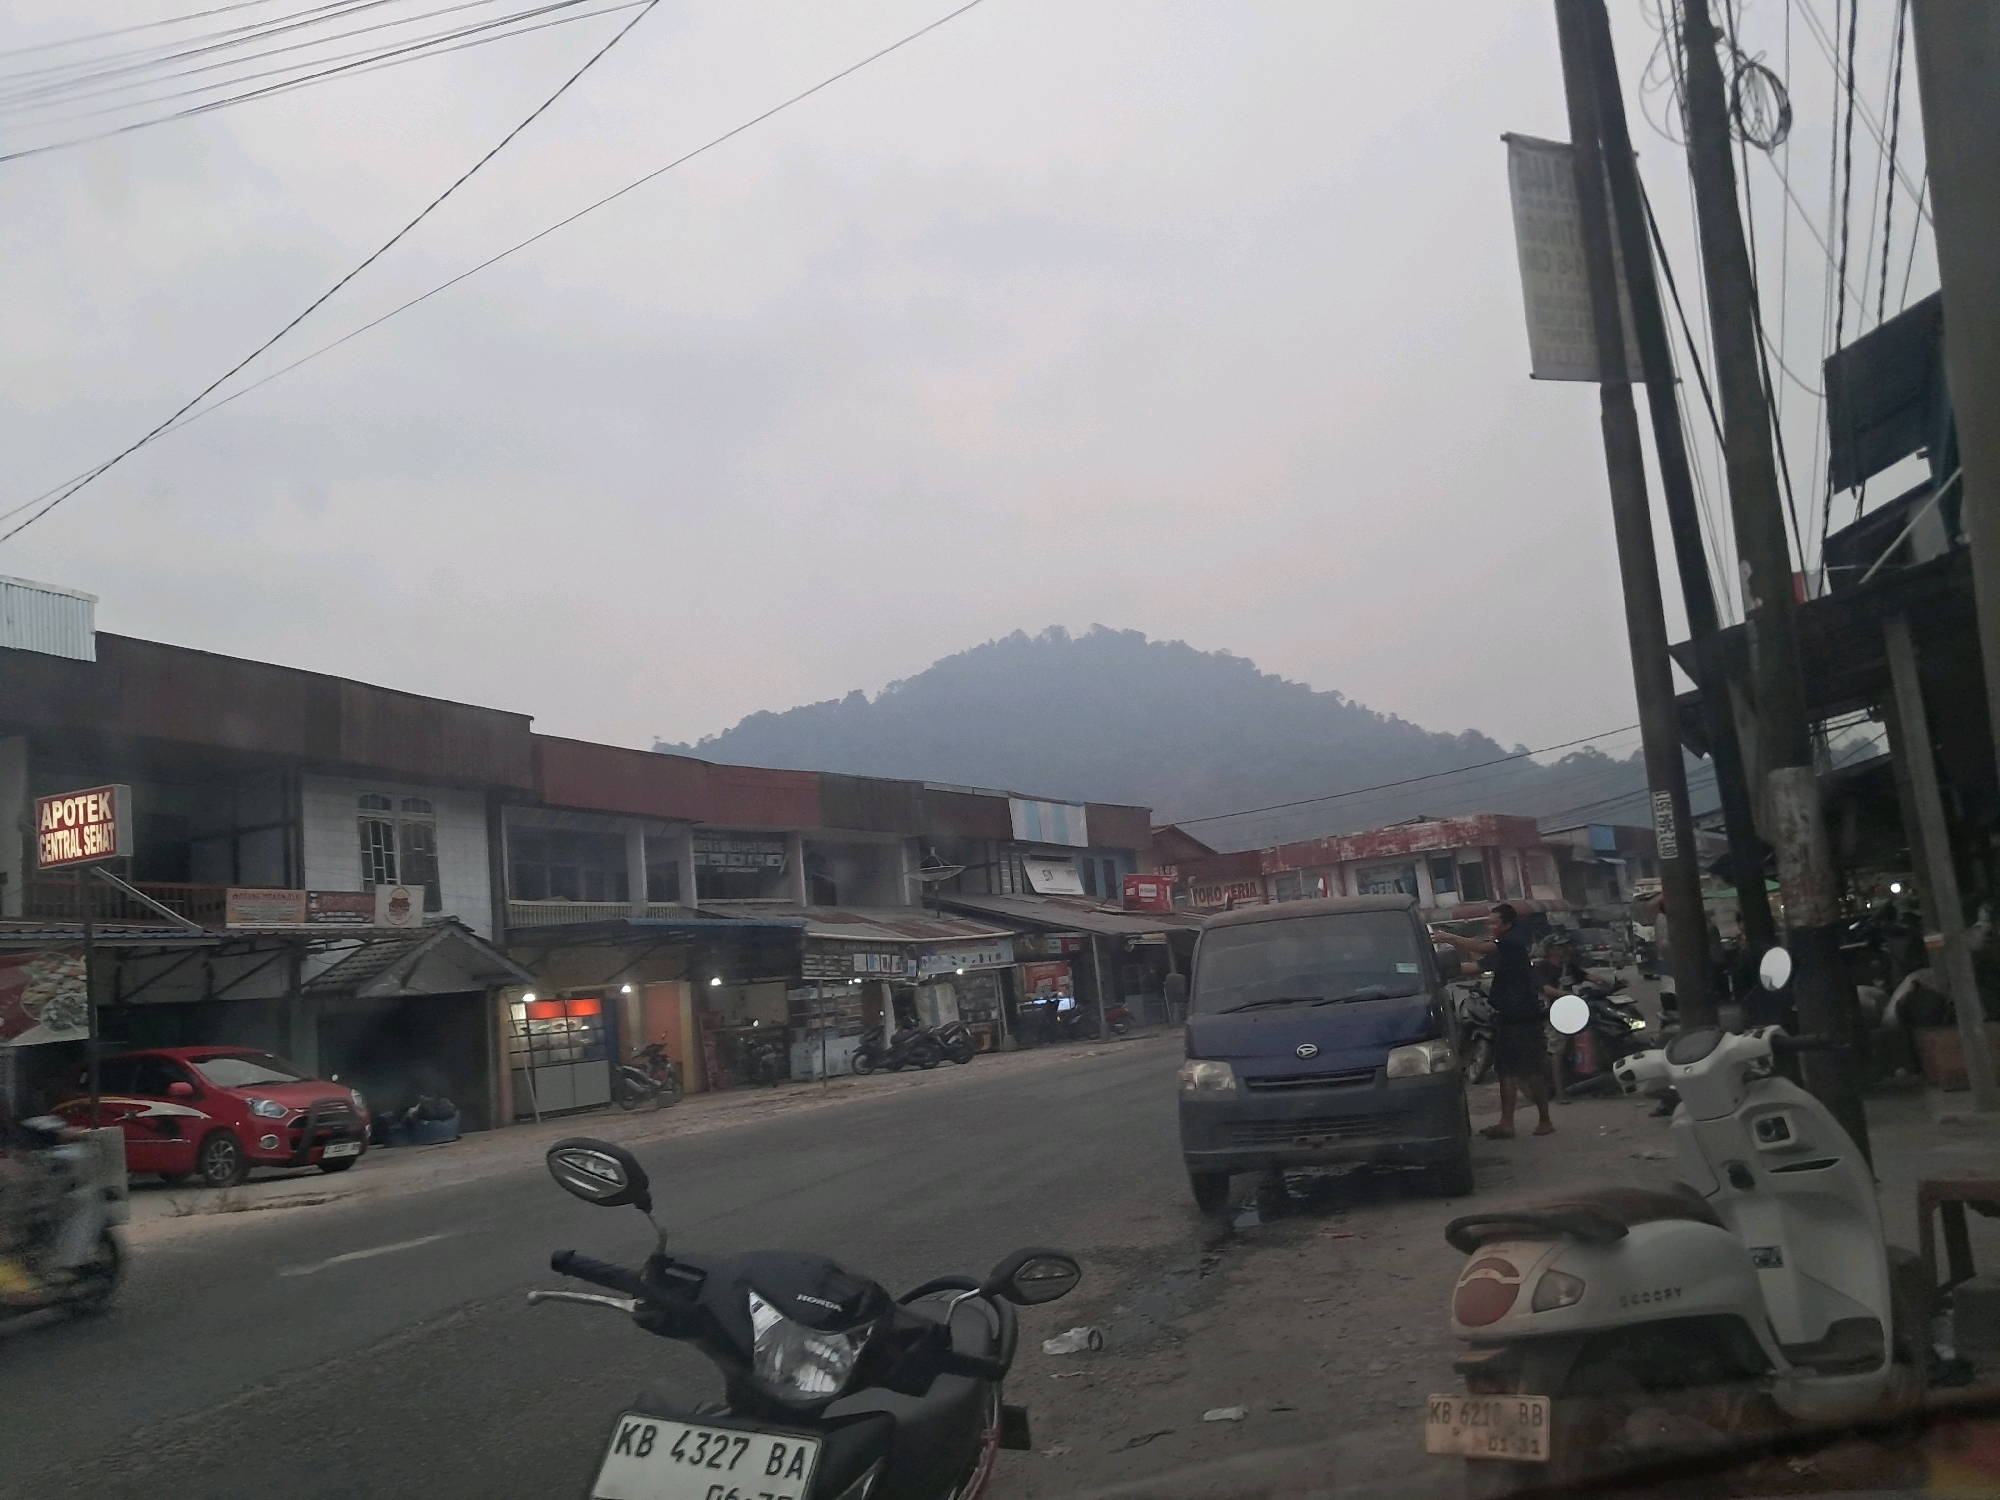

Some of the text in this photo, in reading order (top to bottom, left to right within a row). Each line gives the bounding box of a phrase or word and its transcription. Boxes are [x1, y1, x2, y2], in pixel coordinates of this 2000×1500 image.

[41, 792, 113, 831] APOTEK
[40, 822, 114, 863] CENTRAL SEHAT
[1192, 886, 1222, 904] TOKO
[796, 1293, 843, 1313] HONDA
[1430, 1401, 1451, 1424] KB
[1519, 1402, 1543, 1426] BB
[614, 1422, 807, 1481] KB 4327 BA
